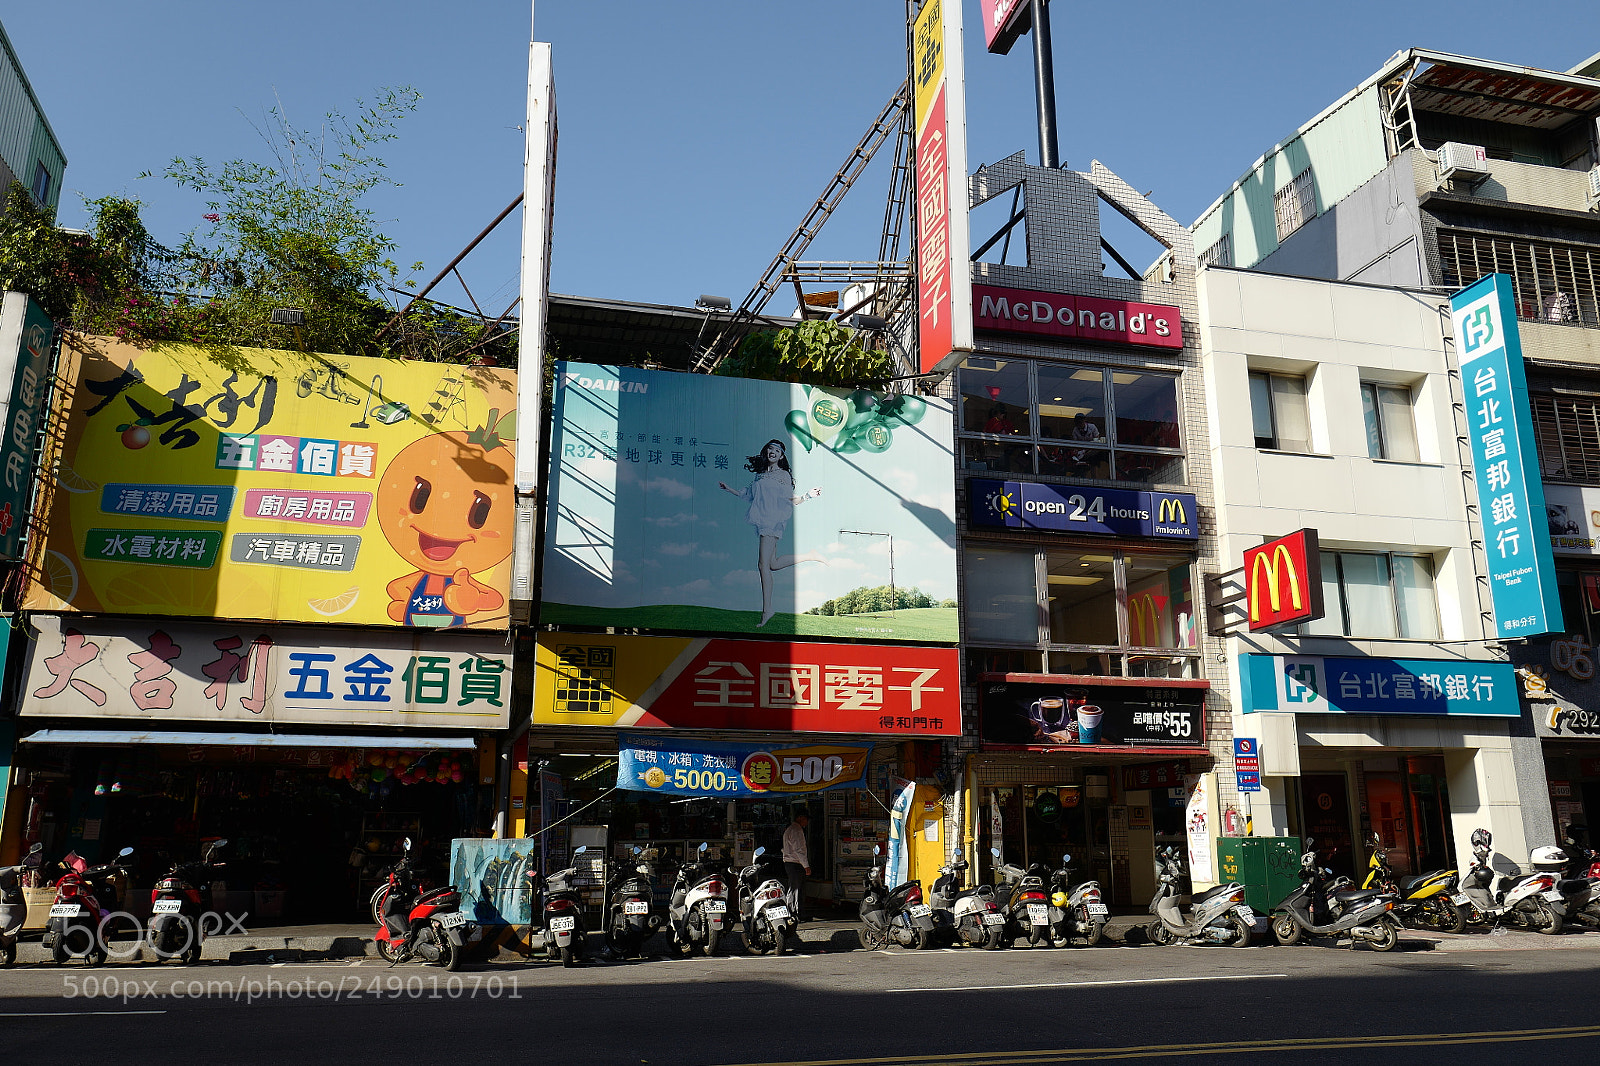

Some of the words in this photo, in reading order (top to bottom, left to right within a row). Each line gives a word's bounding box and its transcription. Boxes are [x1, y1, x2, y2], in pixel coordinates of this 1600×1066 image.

[917, 4, 941, 49] 全國
[919, 128, 948, 330] 全國電子
[980, 295, 1171, 337] McDonald's
[578, 377, 649, 394] DAIKIN
[83, 359, 278, 450] 大吉利
[815, 405, 839, 421] R32
[219, 436, 376, 478] 五金佰貨
[1473, 366, 1520, 559] 台北富邦銀行
[116, 489, 220, 517] 清潔用品
[256, 493, 357, 523] 廚房用品
[1025, 499, 1065, 516] open
[1068, 494, 1107, 522] 24
[1110, 504, 1150, 521] hours
[101, 534, 207, 562] 水電材料
[245, 538, 346, 567] 汽車精品
[1494, 570, 1512, 581] Taipei
[1512, 566, 1533, 577] Fubon
[1505, 577, 1522, 586] Bank
[412, 594, 444, 613] 大吉利
[557, 645, 615, 667] 全國
[33, 627, 275, 714] 大吉利
[284, 652, 505, 708] 五金佰貨
[693, 660, 944, 712] 全國電子
[1338, 671, 1495, 702] 台北富邦銀行
[879, 714, 944, 730] 得和門市
[674, 769, 738, 791] 5000元
[749, 761, 772, 784] 送
